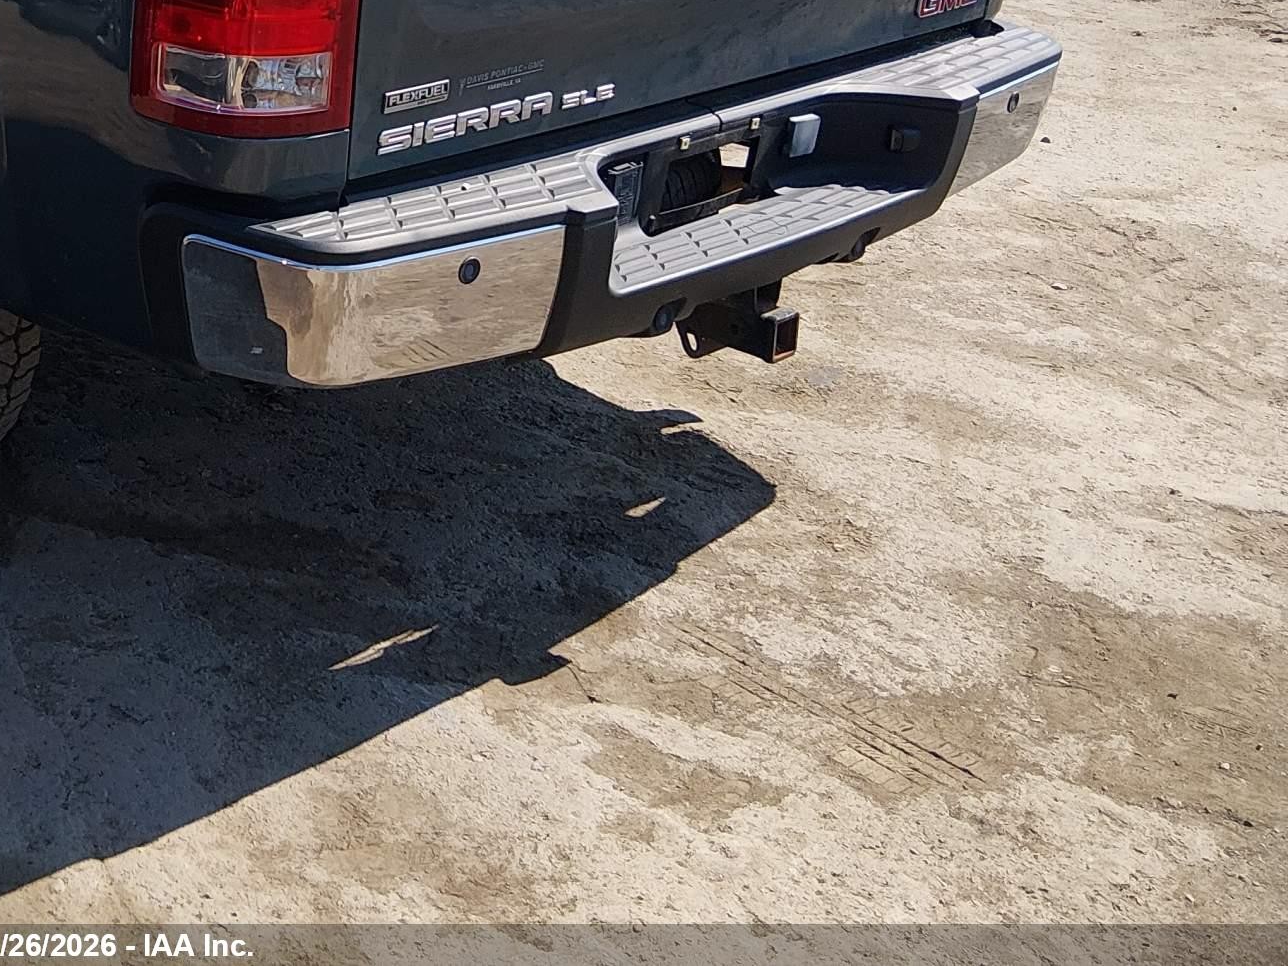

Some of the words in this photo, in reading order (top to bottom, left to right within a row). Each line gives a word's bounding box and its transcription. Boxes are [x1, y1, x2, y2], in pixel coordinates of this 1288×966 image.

[377, 91, 554, 156] SIERRA
[561, 83, 616, 110] SLE
[388, 85, 449, 107] FLEXFUEL
